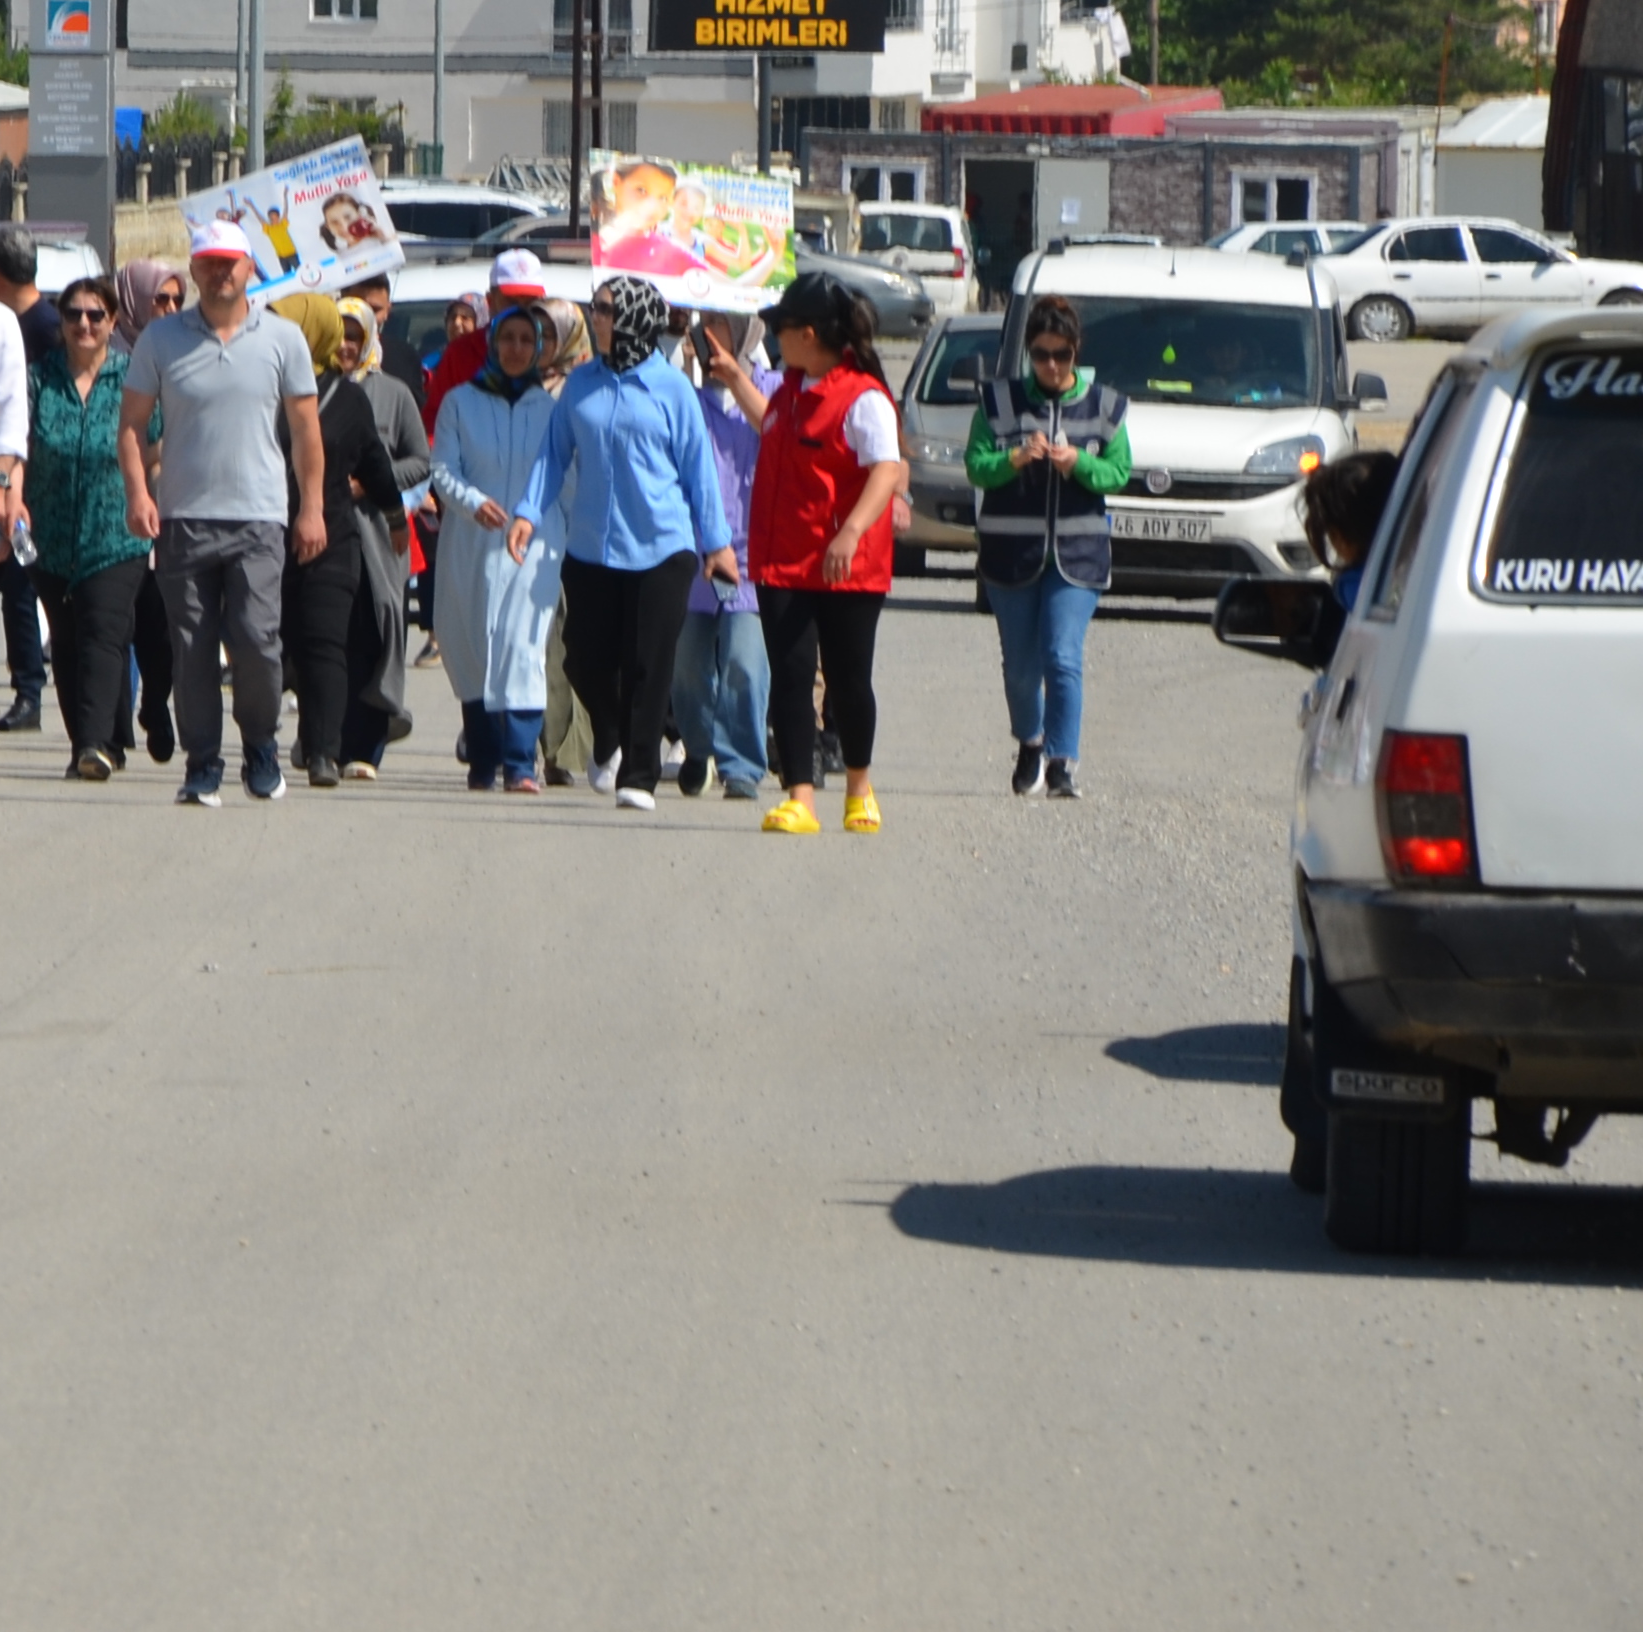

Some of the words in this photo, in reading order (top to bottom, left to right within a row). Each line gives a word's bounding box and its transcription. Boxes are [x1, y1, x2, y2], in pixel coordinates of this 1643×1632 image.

[294, 184, 333, 206] Mutlu
[336, 170, 368, 190] Yaşa
[1544, 355, 1643, 400] Ha
[1178, 518, 1207, 541] 507
[1494, 558, 1575, 593] KURU
